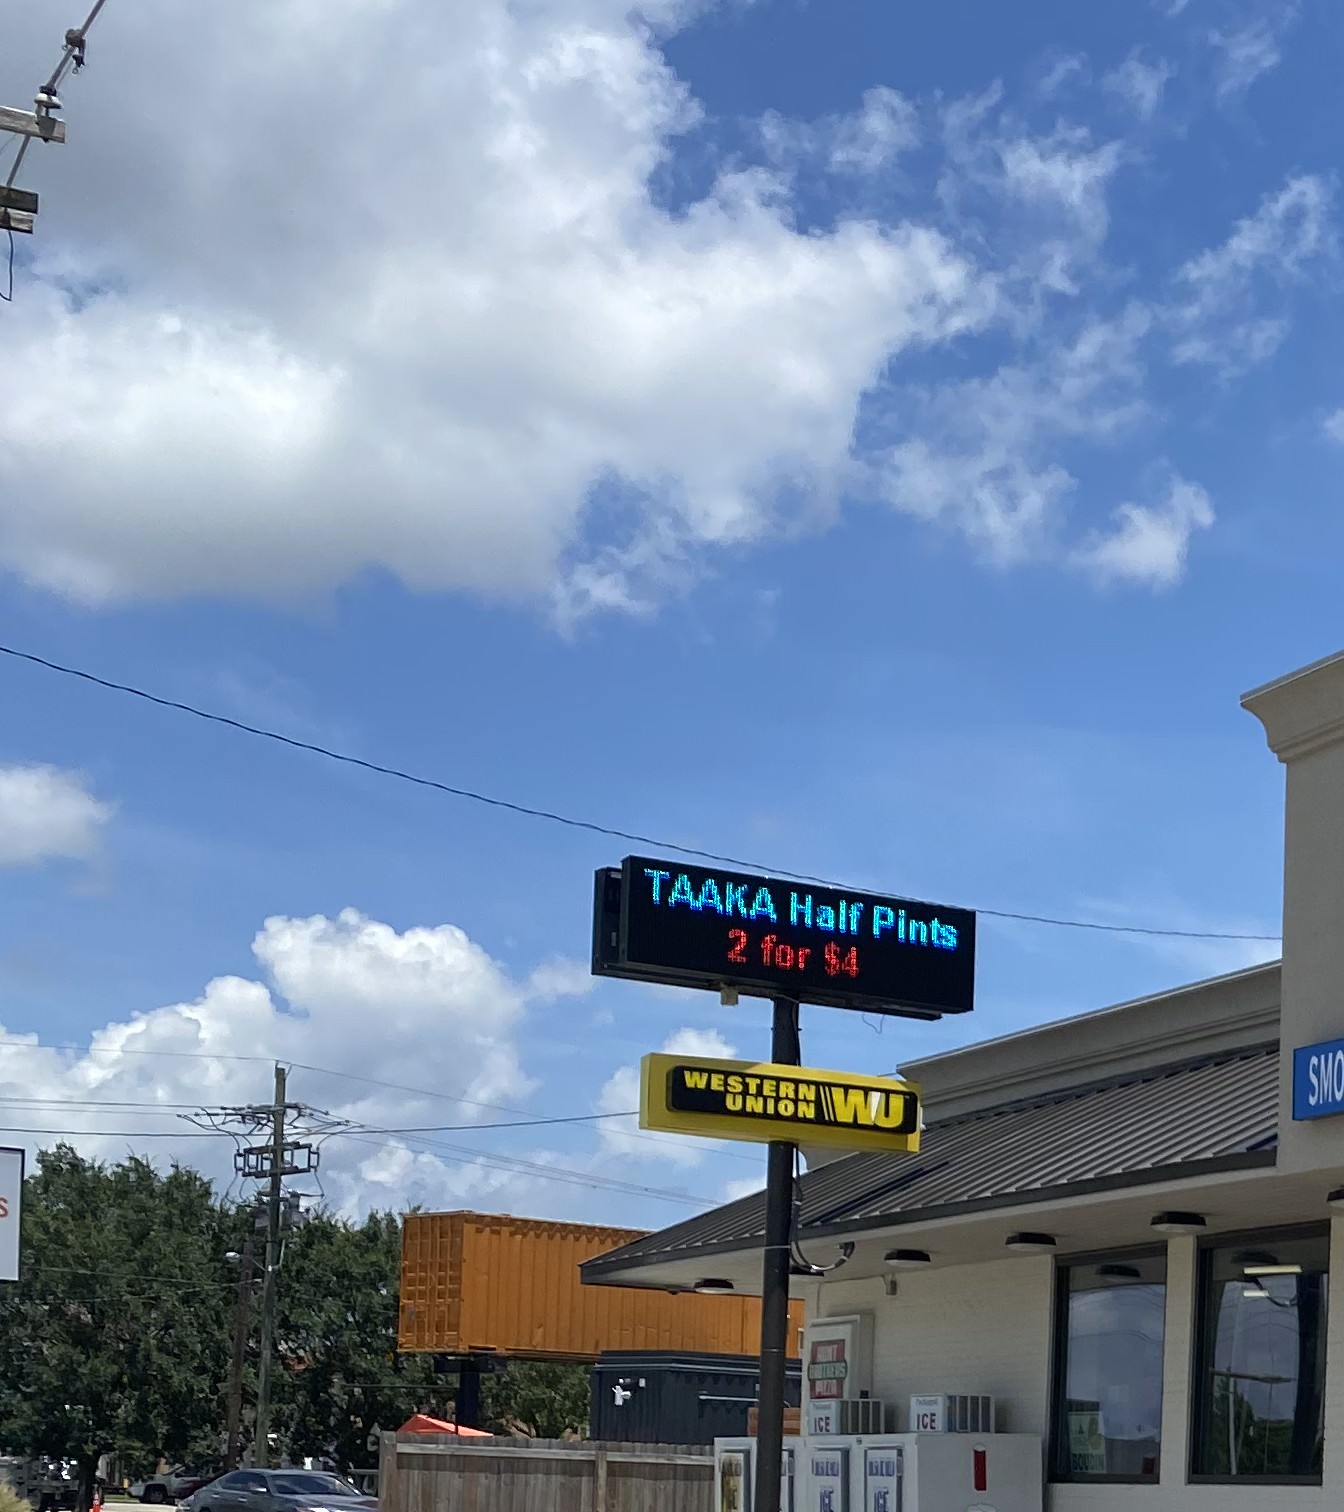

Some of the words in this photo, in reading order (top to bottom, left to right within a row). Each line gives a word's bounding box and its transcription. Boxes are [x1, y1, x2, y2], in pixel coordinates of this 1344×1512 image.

[644, 868, 777, 923] TAAKA
[790, 891, 864, 935] Half
[873, 905, 960, 951] Pints
[727, 928, 747, 964] 2
[761, 933, 811, 970] for
[824, 940, 860, 979] $4
[683, 1070, 816, 1102] WESTERN
[725, 1093, 816, 1119] UNION
[831, 1086, 904, 1128] WU
[814, 1417, 830, 1432] ICE
[917, 1413, 936, 1429] ICE
[820, 1488, 834, 1512] ICE
